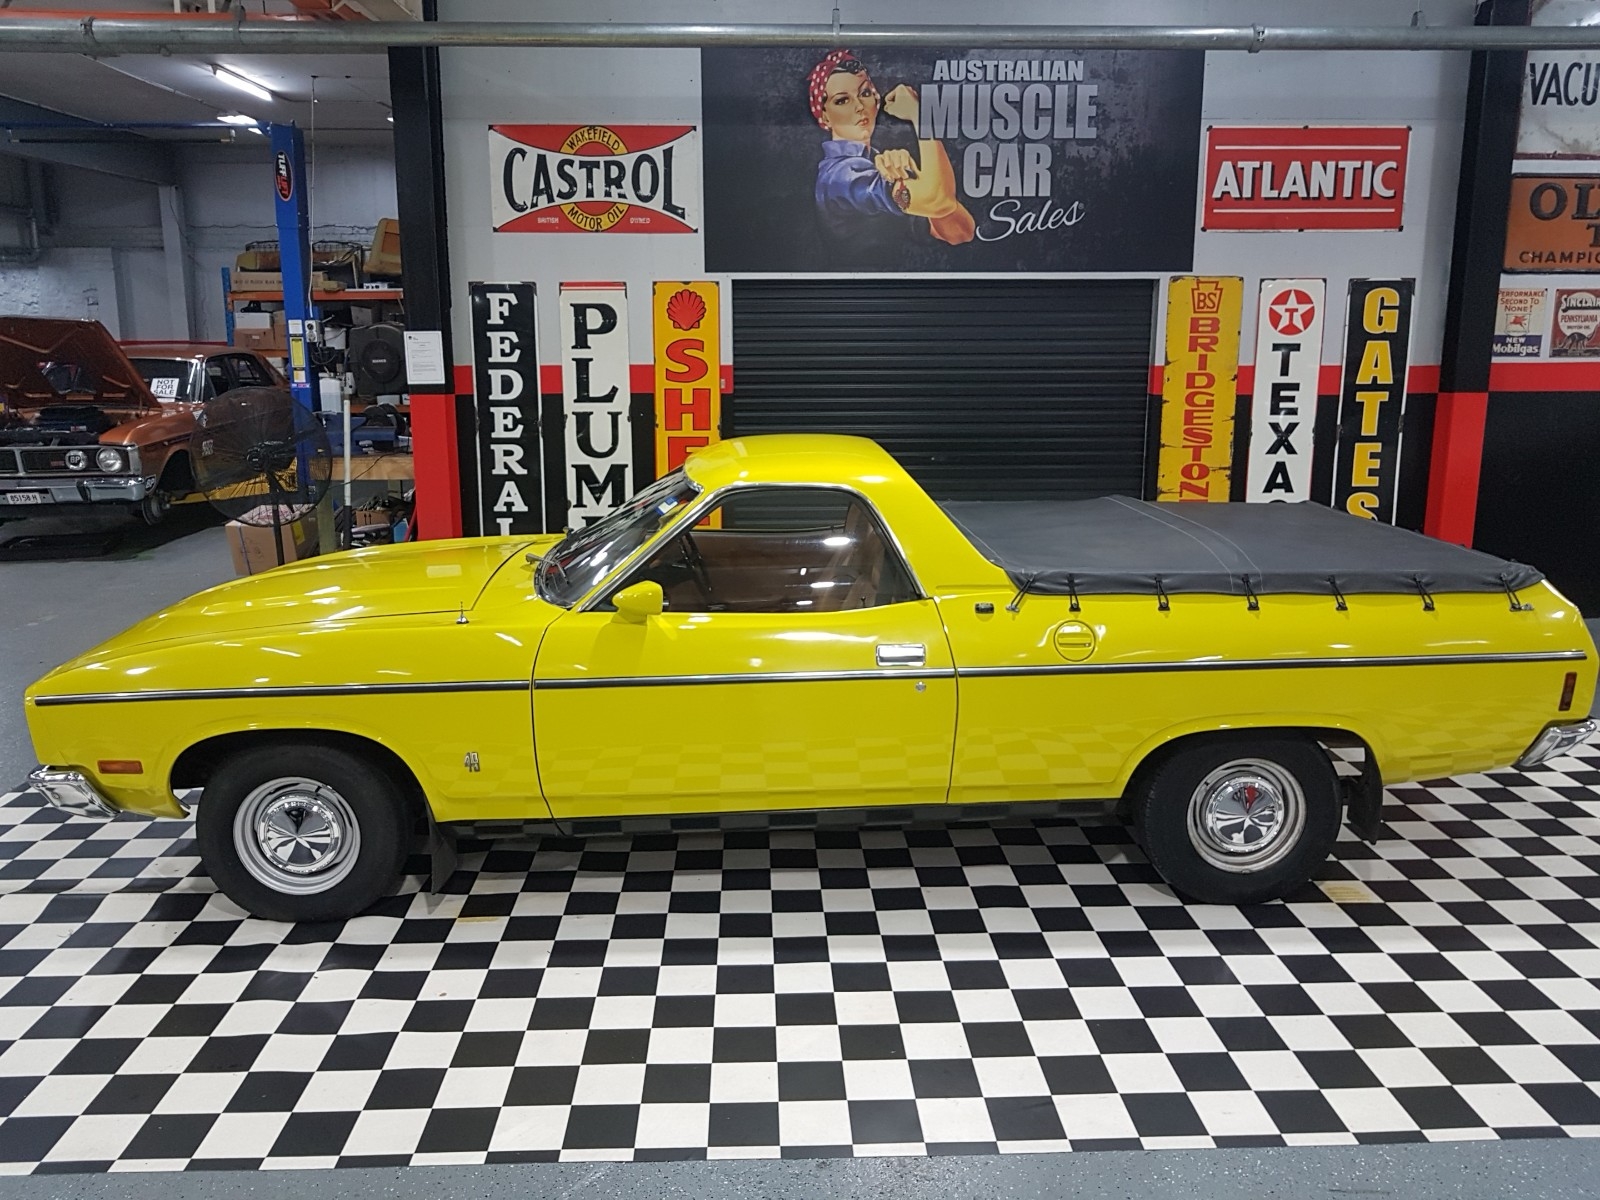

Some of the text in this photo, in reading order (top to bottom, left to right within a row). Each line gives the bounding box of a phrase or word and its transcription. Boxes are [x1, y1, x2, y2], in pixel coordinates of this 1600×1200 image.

[933, 60, 1084, 82] AUSTRALIAN
[920, 84, 1098, 140] MUSCLE
[567, 128, 620, 151] WAKEFIELD
[503, 145, 686, 220] CASTROL
[963, 143, 1052, 198] CAR
[1212, 160, 1399, 200] ATLANTIC
[567, 205, 625, 230] MOTOR OIL
[1529, 182, 1600, 220] OL
[975, 199, 1086, 242] Sales
[1197, 292, 1217, 310] BS
[1500, 297, 1528, 305] SECOND
[1505, 305, 1533, 313] NONE!
[1493, 343, 1539, 357] Mobilgas
[1506, 336, 1526, 344] NEW
[569, 302, 629, 531] PLUM
[1178, 316, 1221, 502] BRIDGESTON
[1262, 342, 1302, 503] TEXA
